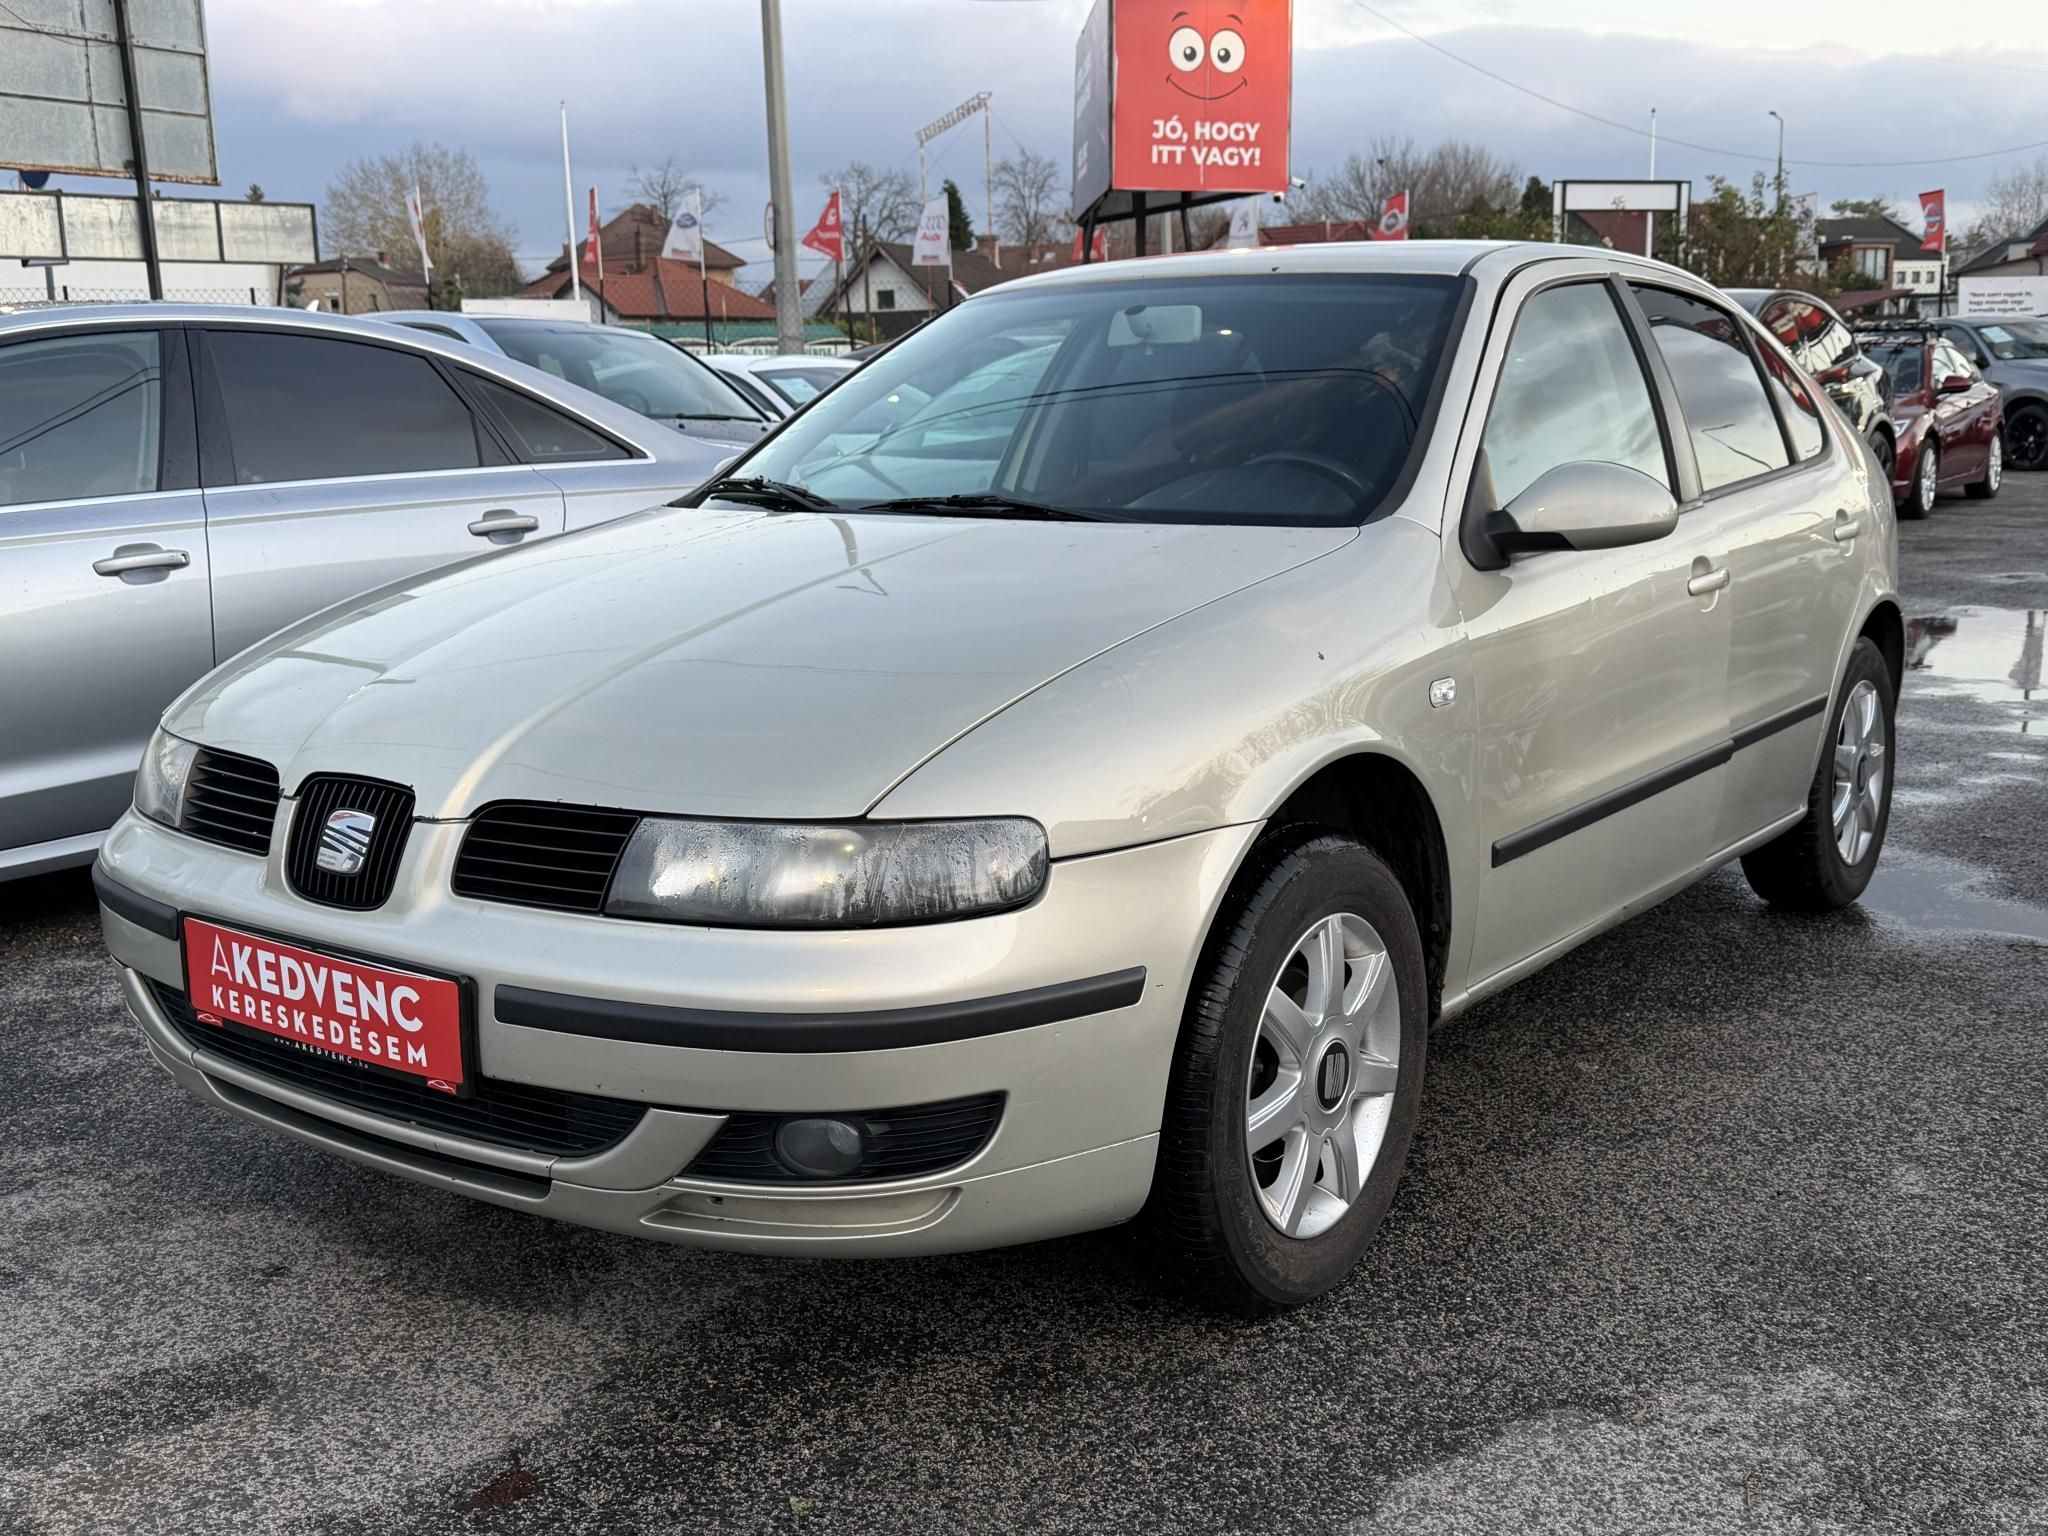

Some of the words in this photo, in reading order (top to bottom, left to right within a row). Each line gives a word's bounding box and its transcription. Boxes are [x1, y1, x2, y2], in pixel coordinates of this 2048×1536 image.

[1151, 145, 1186, 164] ITT
[1191, 147, 1261, 166] VAGY!
[1152, 115, 1188, 143] JÓ,
[1194, 122, 1260, 142] HOGY
[211, 934, 424, 1032] AKEDVENC
[211, 984, 428, 1068] KERESKEDÉSEM
